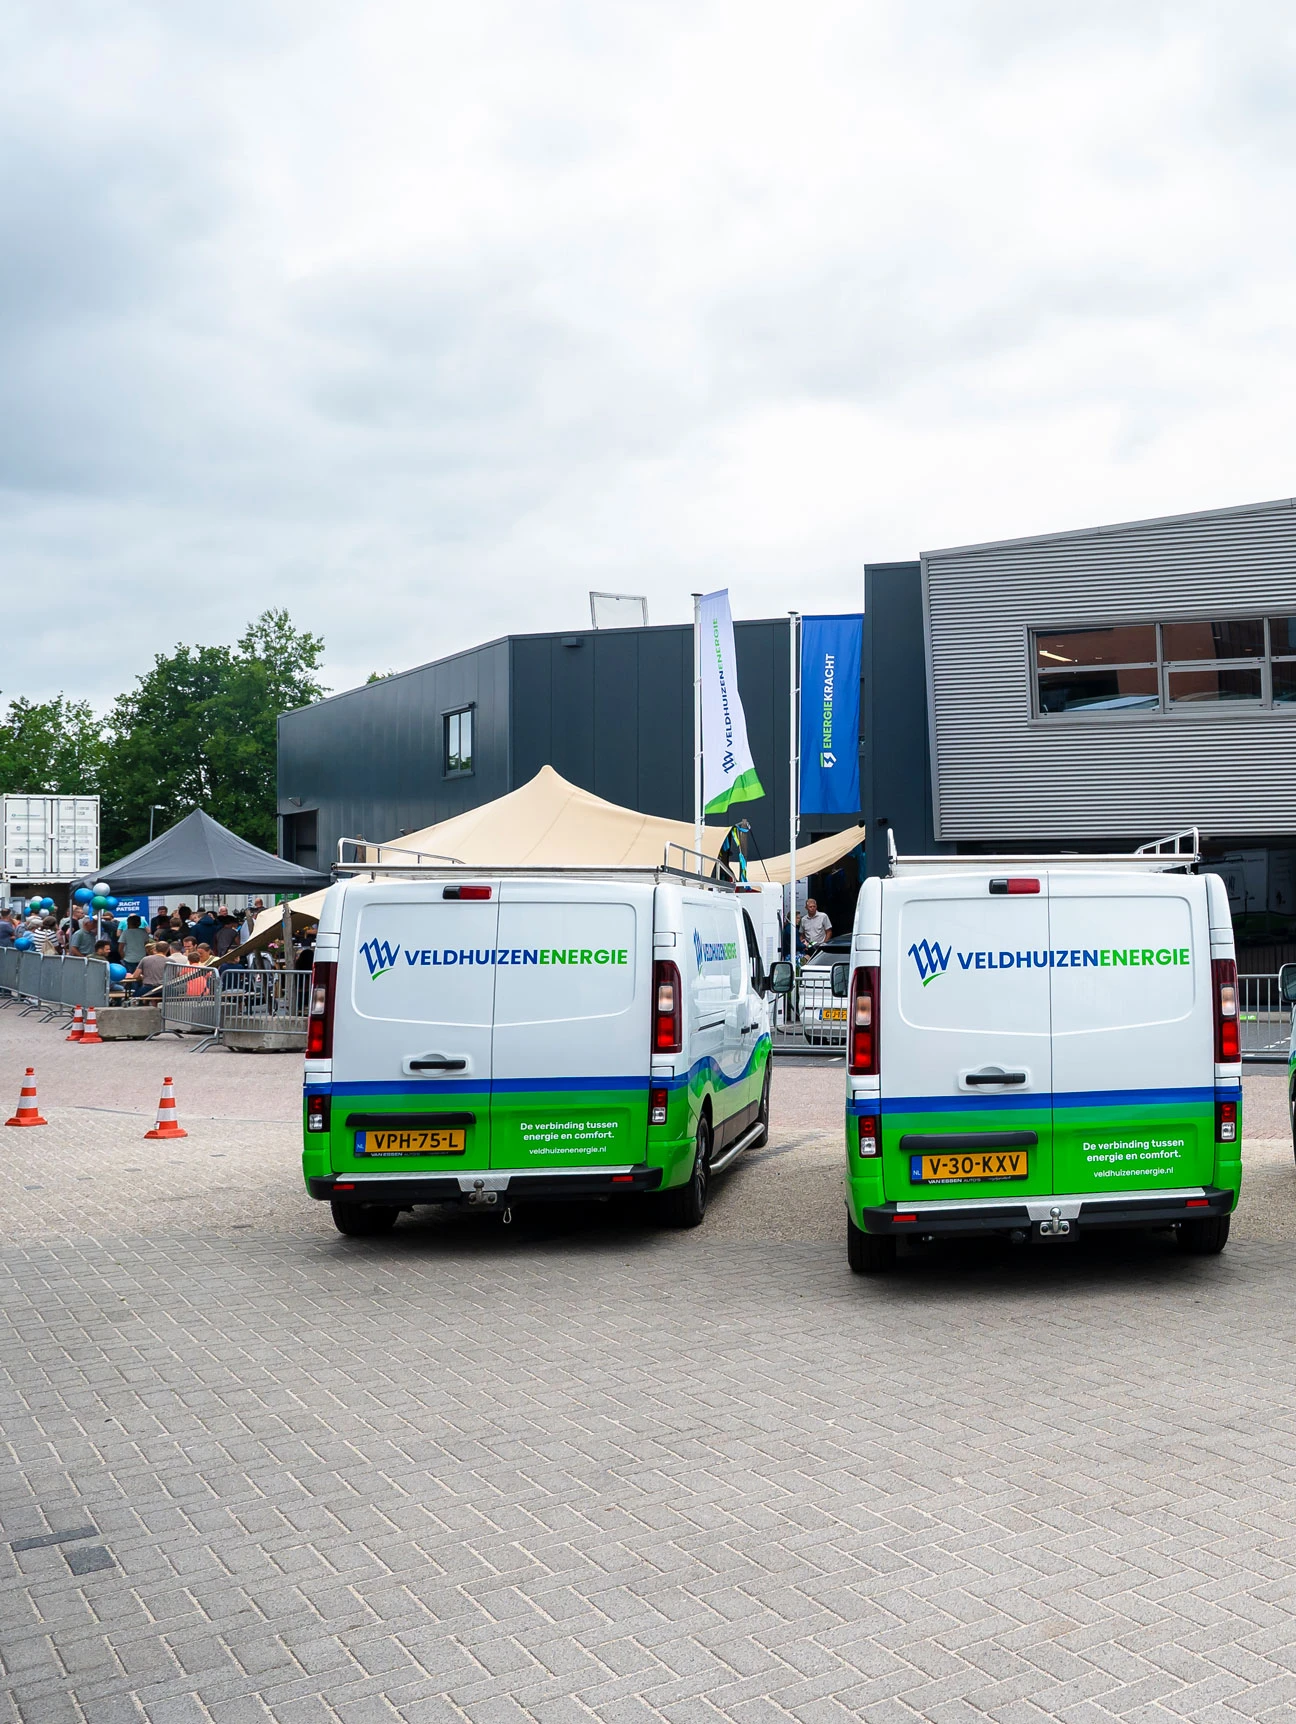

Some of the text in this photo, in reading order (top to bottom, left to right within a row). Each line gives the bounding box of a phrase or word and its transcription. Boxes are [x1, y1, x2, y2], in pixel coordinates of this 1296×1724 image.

[713, 618, 733, 747] VELDHUIZENENERGIE
[823, 653, 835, 749] ENERGIEKRACHT
[405, 949, 628, 966] VELDHUIZENENERGIE
[957, 948, 1190, 970] VELDHUIZENENERGIE
[520, 1121, 618, 1131] De verbinding tussen
[374, 1132, 458, 1149] VPH-75-L
[523, 1132, 559, 1141] energie
[574, 1131, 614, 1139] comfort.
[529, 1146, 607, 1154] veldhuizenenergie.nl
[1083, 1139, 1184, 1150] De verbinding tussen
[1087, 1152, 1123, 1163] energie
[1139, 1149, 1181, 1160] comfort.
[929, 1154, 1020, 1175] V-30-KXV
[1093, 1166, 1174, 1178] veldhuizenenergie.nl
